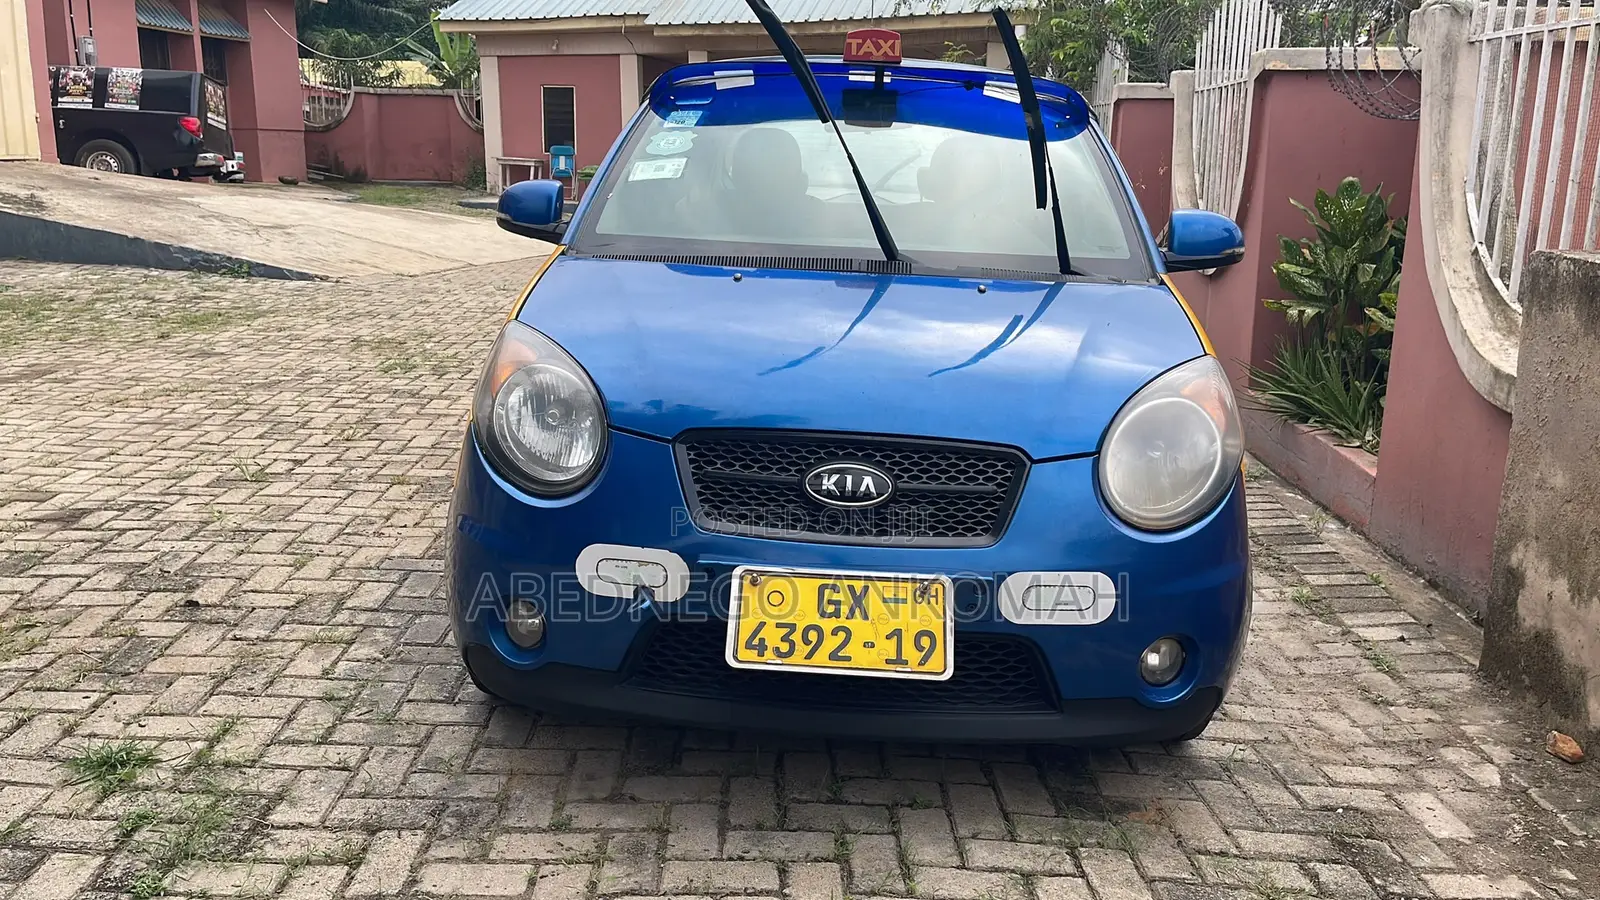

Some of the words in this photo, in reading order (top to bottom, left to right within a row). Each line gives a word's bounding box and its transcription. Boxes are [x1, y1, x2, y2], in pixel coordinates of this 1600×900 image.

[846, 38, 901, 56] TAXI
[820, 472, 877, 497] KIA
[817, 583, 870, 621] GX
